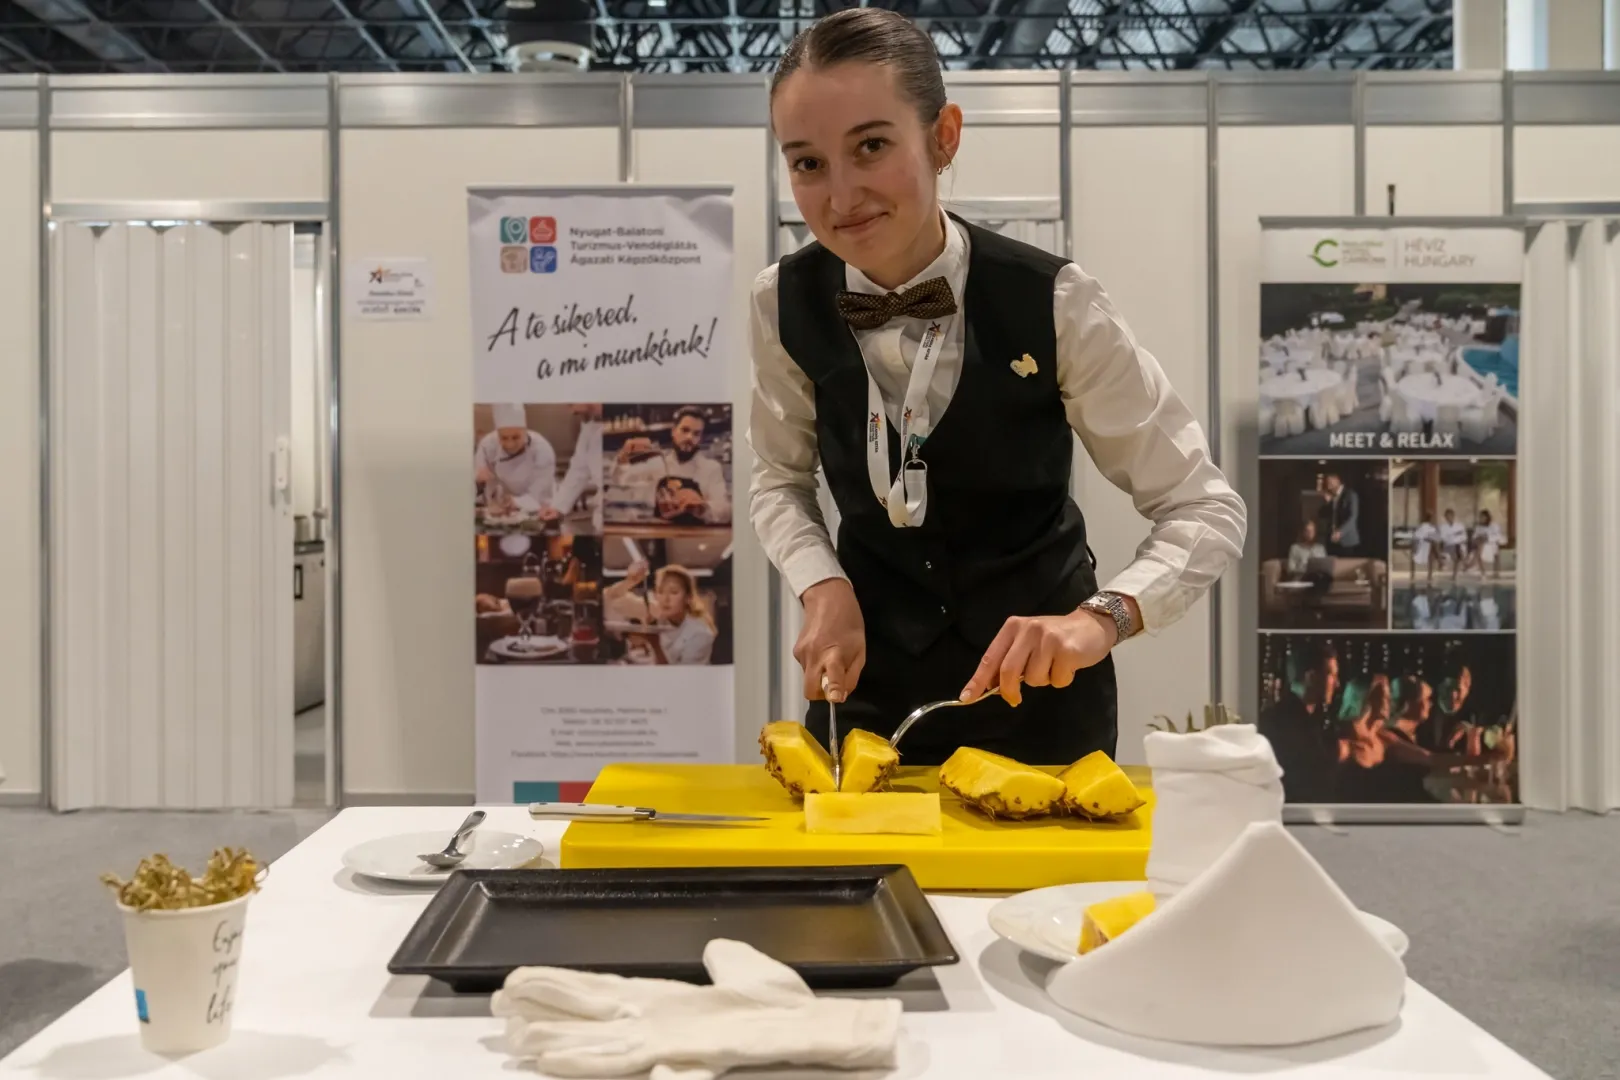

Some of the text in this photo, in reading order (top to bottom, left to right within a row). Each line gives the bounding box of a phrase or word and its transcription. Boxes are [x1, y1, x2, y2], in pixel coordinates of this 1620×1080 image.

[569, 227, 664, 238] Nyugat-Balatoni
[570, 241, 698, 251] Turizmus-Vendéglátás
[570, 254, 614, 266] Ágazati
[1404, 254, 1475, 267] HUNGARY
[487, 307, 519, 351] A
[525, 312, 546, 339] te
[537, 316, 718, 379] a mi munkánk!
[1330, 433, 1454, 448] MEET & RELAX
